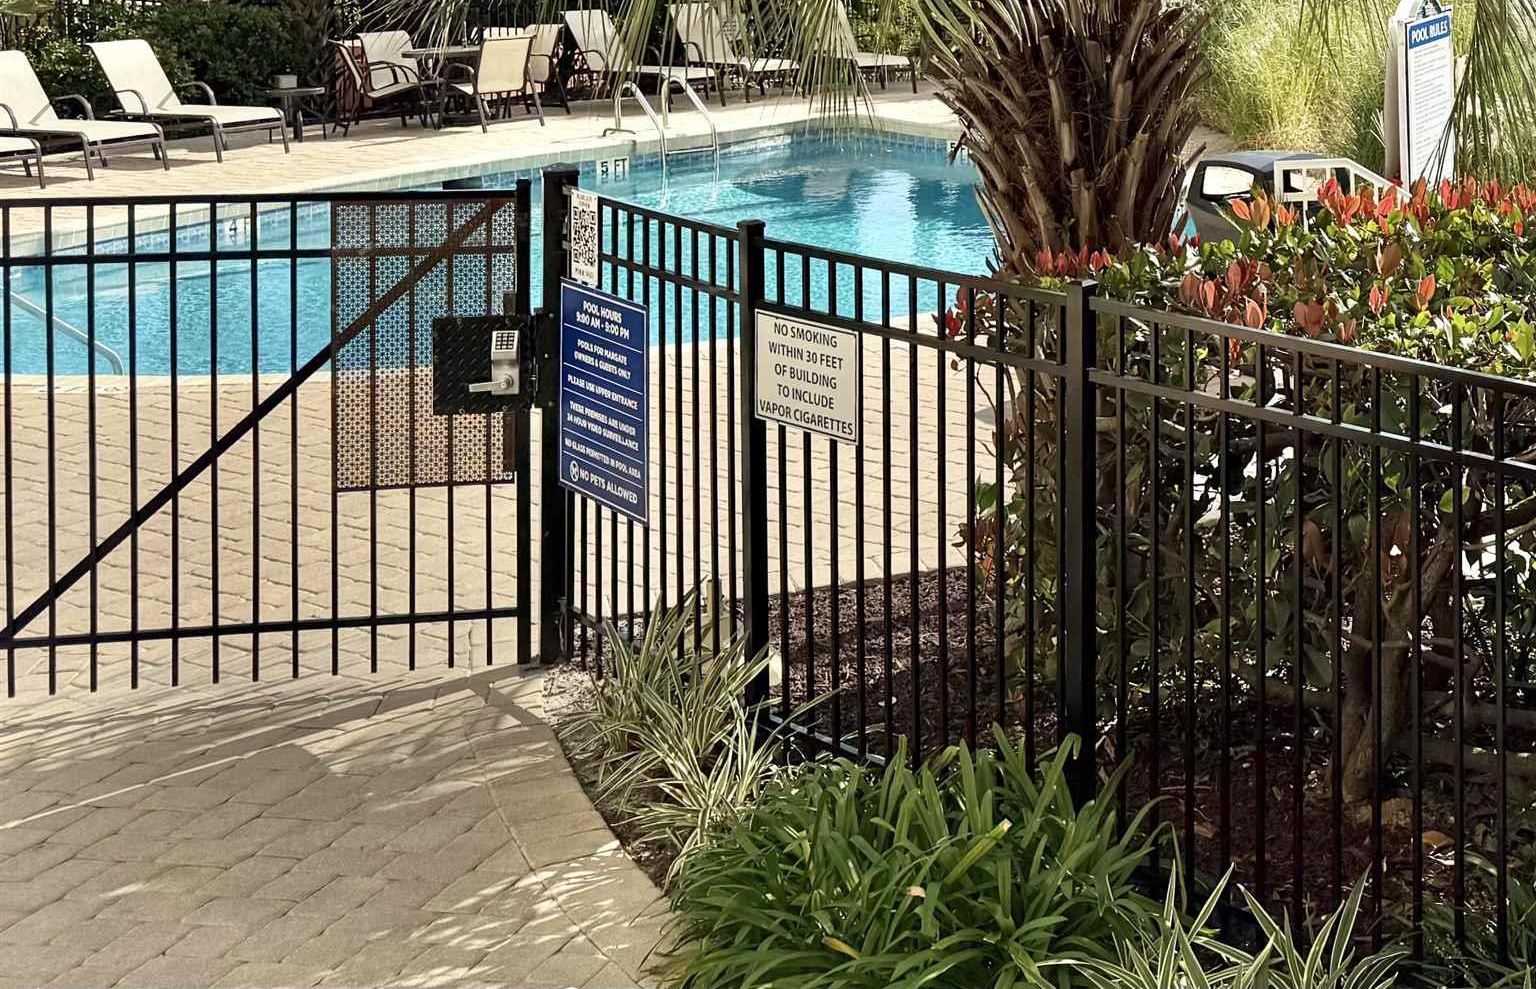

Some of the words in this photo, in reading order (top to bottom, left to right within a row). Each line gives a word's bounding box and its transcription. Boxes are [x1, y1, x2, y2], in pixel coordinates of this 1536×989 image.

[1411, 27, 1429, 44] POOL
[1430, 20, 1448, 38] RULES
[601, 161, 609, 173] 5
[614, 158, 628, 172] FT
[583, 301, 600, 315] POOL
[601, 307, 622, 323] HOURS
[576, 312, 590, 325] 9:00
[591, 316, 600, 329] AM
[605, 322, 619, 336] 9:00
[620, 327, 629, 339] PM
[774, 322, 788, 336] NO
[791, 327, 837, 348] SMOKING
[769, 341, 803, 360] WITHIN
[806, 351, 818, 363] 30
[820, 354, 843, 370] FEET
[775, 364, 788, 377] OF
[790, 367, 837, 389] BUILDING
[777, 383, 790, 397] TO
[792, 388, 835, 409] INCLUDE
[760, 399, 792, 419] VAPOR
[794, 409, 853, 435] CIGARETTES
[580, 468, 589, 481] NO
[591, 474, 605, 489] PETS
[606, 481, 638, 504] ALLOWED
